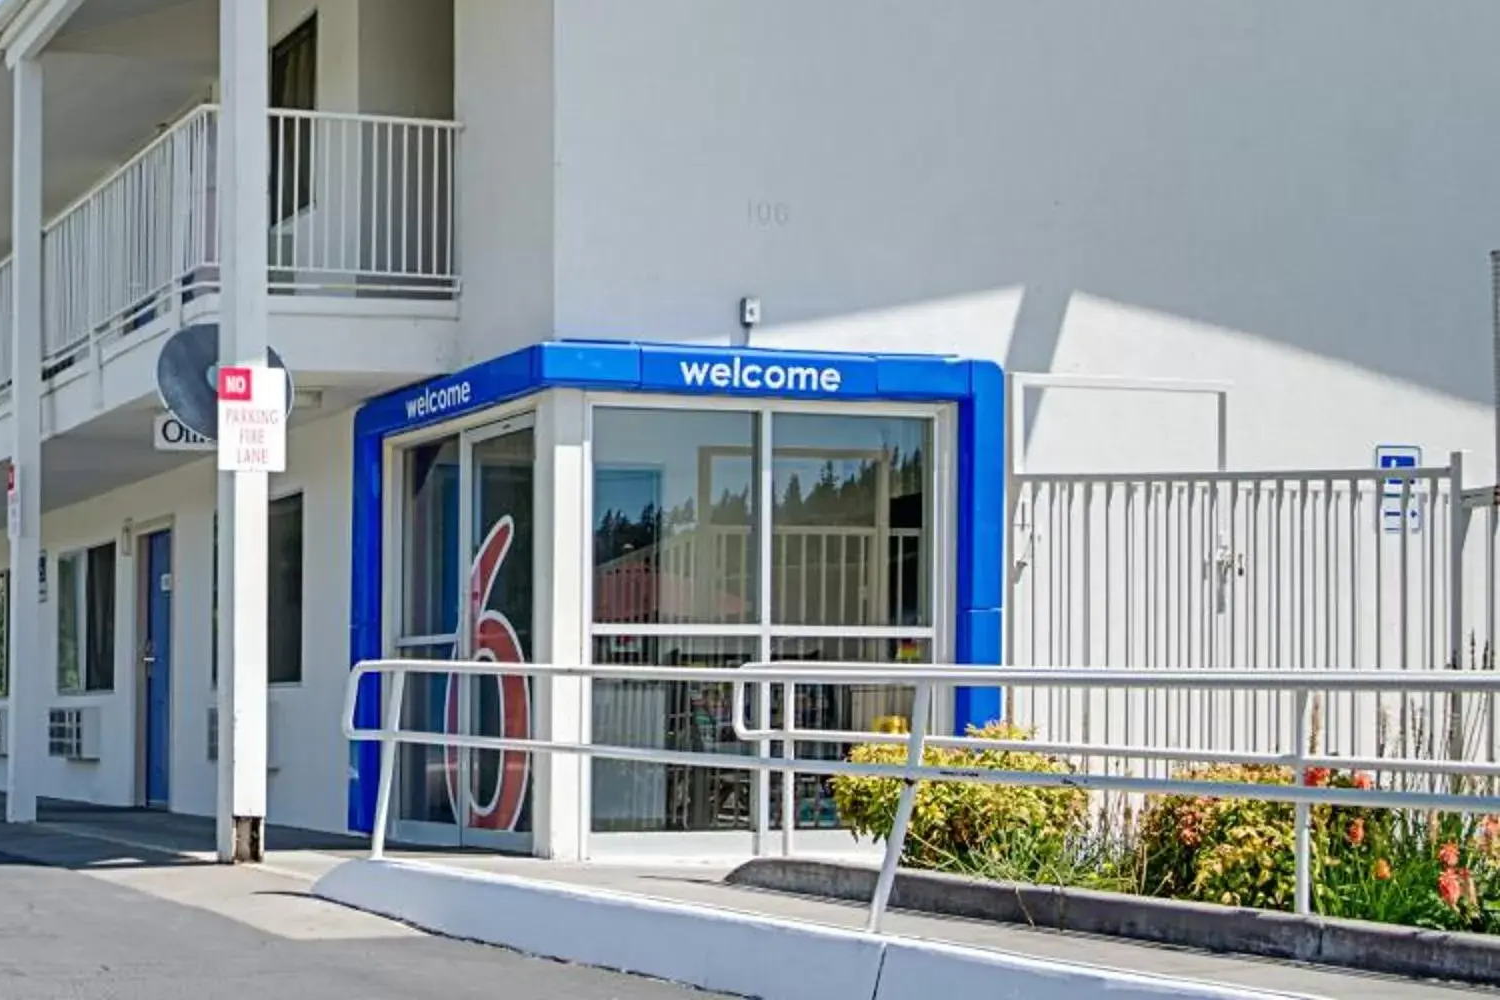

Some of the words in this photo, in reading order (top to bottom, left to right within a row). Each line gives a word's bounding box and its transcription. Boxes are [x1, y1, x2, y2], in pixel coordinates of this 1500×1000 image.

[679, 355, 842, 392] welcome
[225, 375, 247, 394] NO
[404, 381, 471, 420] welcome
[225, 407, 279, 425] PARKING
[239, 427, 265, 445] FIRE
[236, 447, 269, 465] LANE
[444, 515, 530, 832] 6
